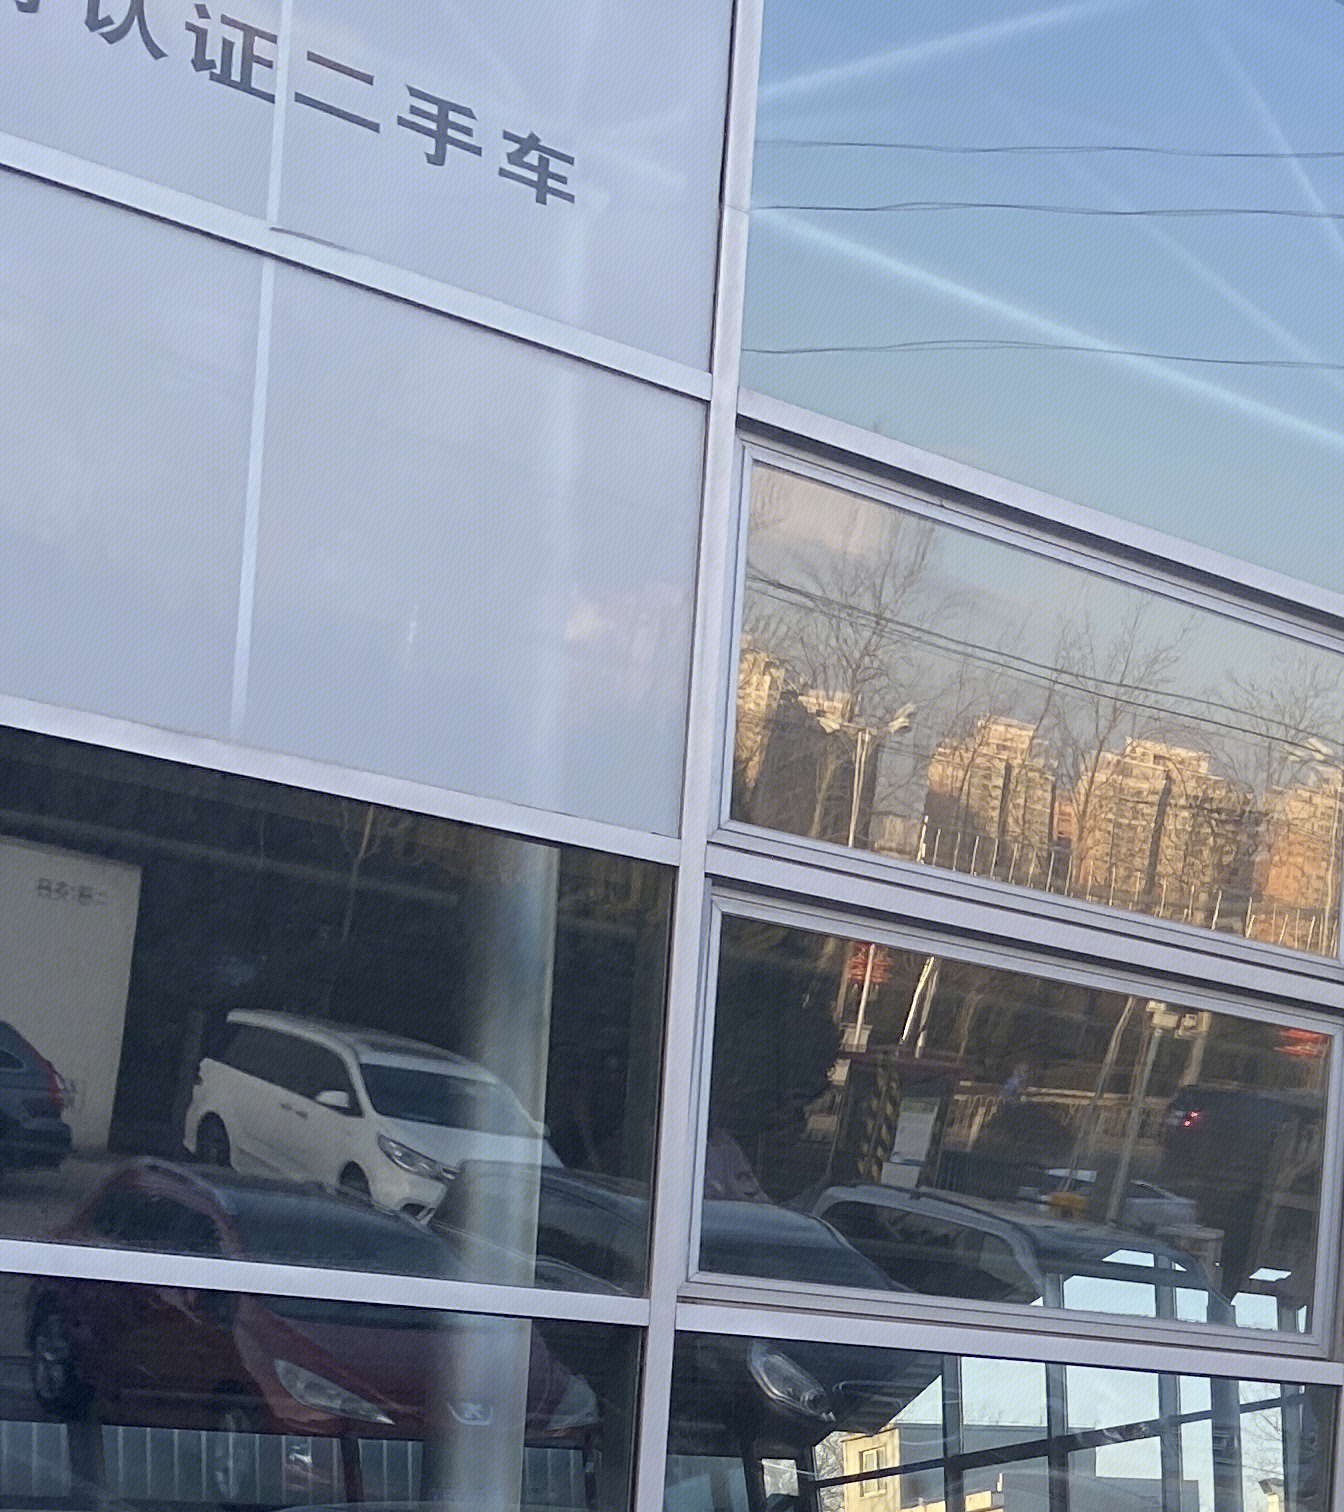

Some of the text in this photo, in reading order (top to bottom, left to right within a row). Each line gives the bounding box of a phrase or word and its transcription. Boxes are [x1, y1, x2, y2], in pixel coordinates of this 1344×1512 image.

[14, 0, 575, 205] 认证二手车
